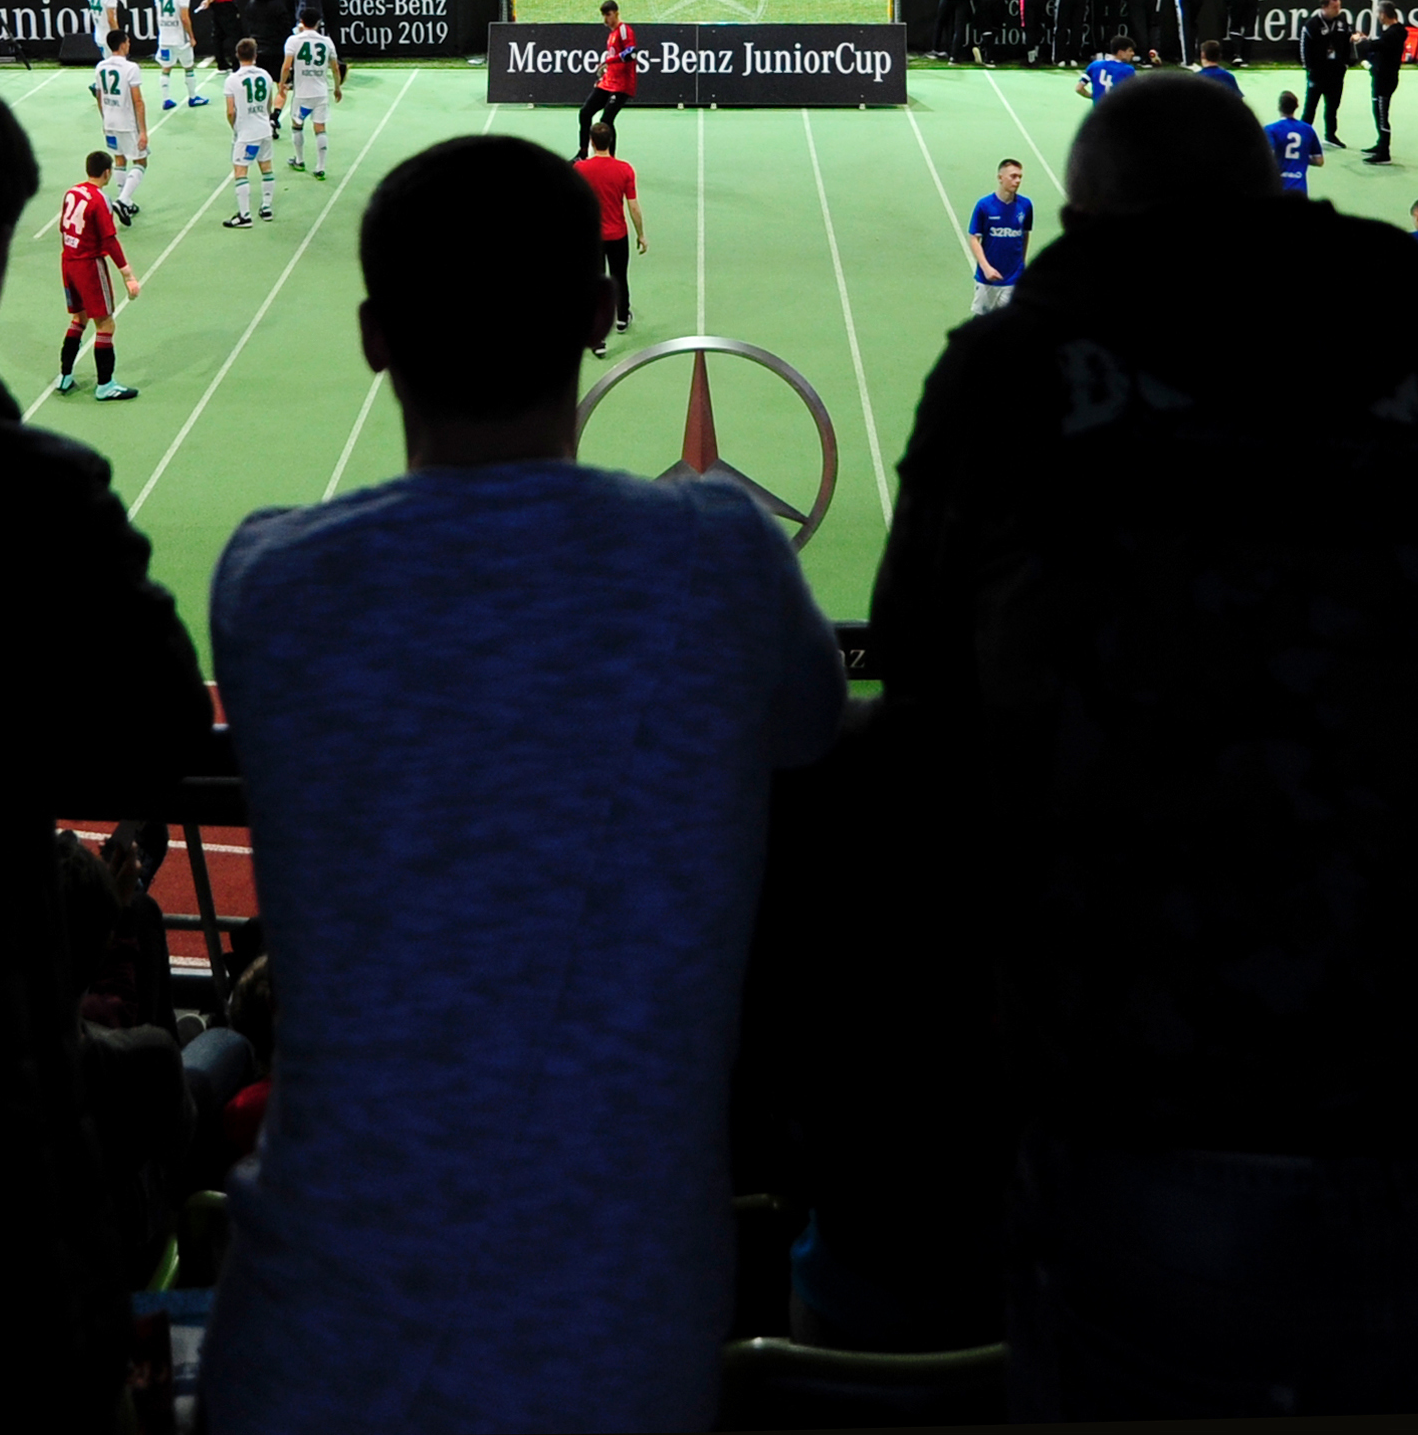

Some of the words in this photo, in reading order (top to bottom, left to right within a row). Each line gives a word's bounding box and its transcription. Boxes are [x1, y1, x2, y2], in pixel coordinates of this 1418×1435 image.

[398, 22, 448, 45] 2019
[297, 41, 327, 67] 43
[506, 41, 733, 74] Merces-Benz
[742, 41, 892, 81] JuniorCup
[99, 68, 121, 96] 12
[242, 75, 268, 104] 18
[1099, 68, 1114, 94] 4
[1284, 131, 1302, 160] 2
[62, 192, 89, 236] 24
[989, 226, 1023, 238] 32Red
